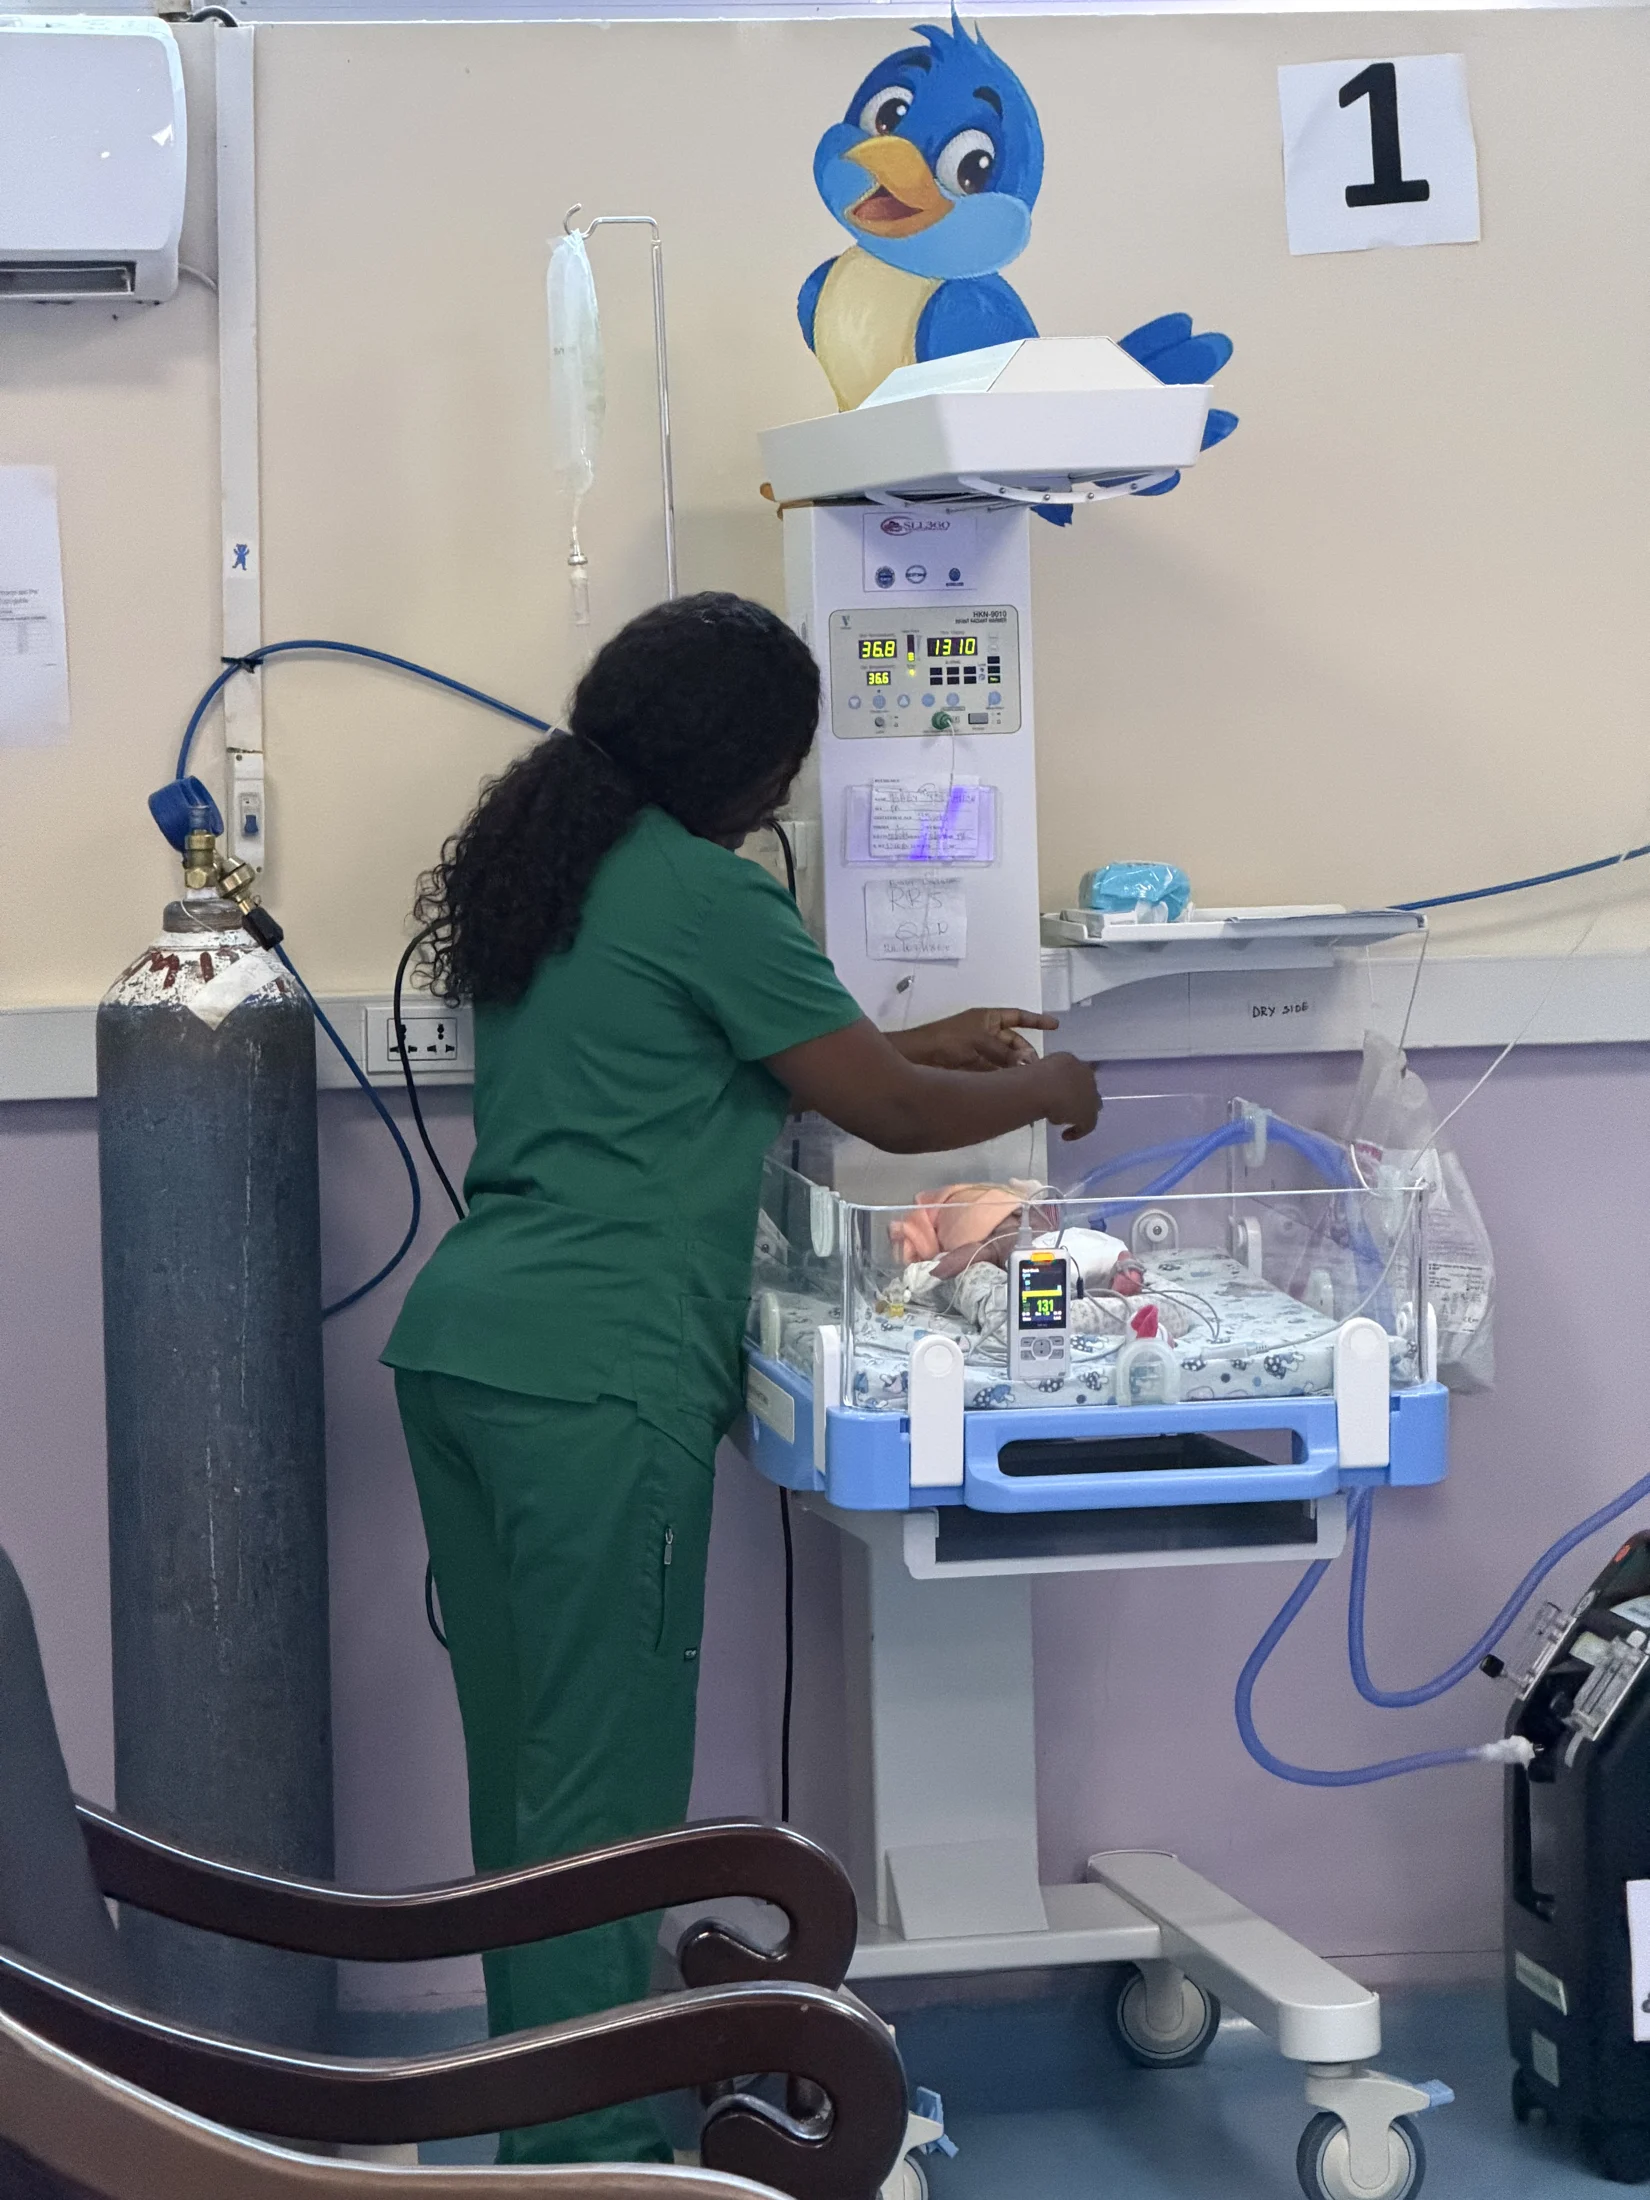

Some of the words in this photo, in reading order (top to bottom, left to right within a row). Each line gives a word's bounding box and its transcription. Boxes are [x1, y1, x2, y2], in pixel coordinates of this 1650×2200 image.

[1339, 62, 1430, 208] 1
[972, 610, 1008, 619] HKN-9010
[861, 640, 896, 658] 36.8
[868, 671, 889, 685] 36.6
[1252, 1005, 1276, 1018] DRY
[1281, 1001, 1309, 1015] SIDE
[1036, 1299, 1054, 1313] 131
